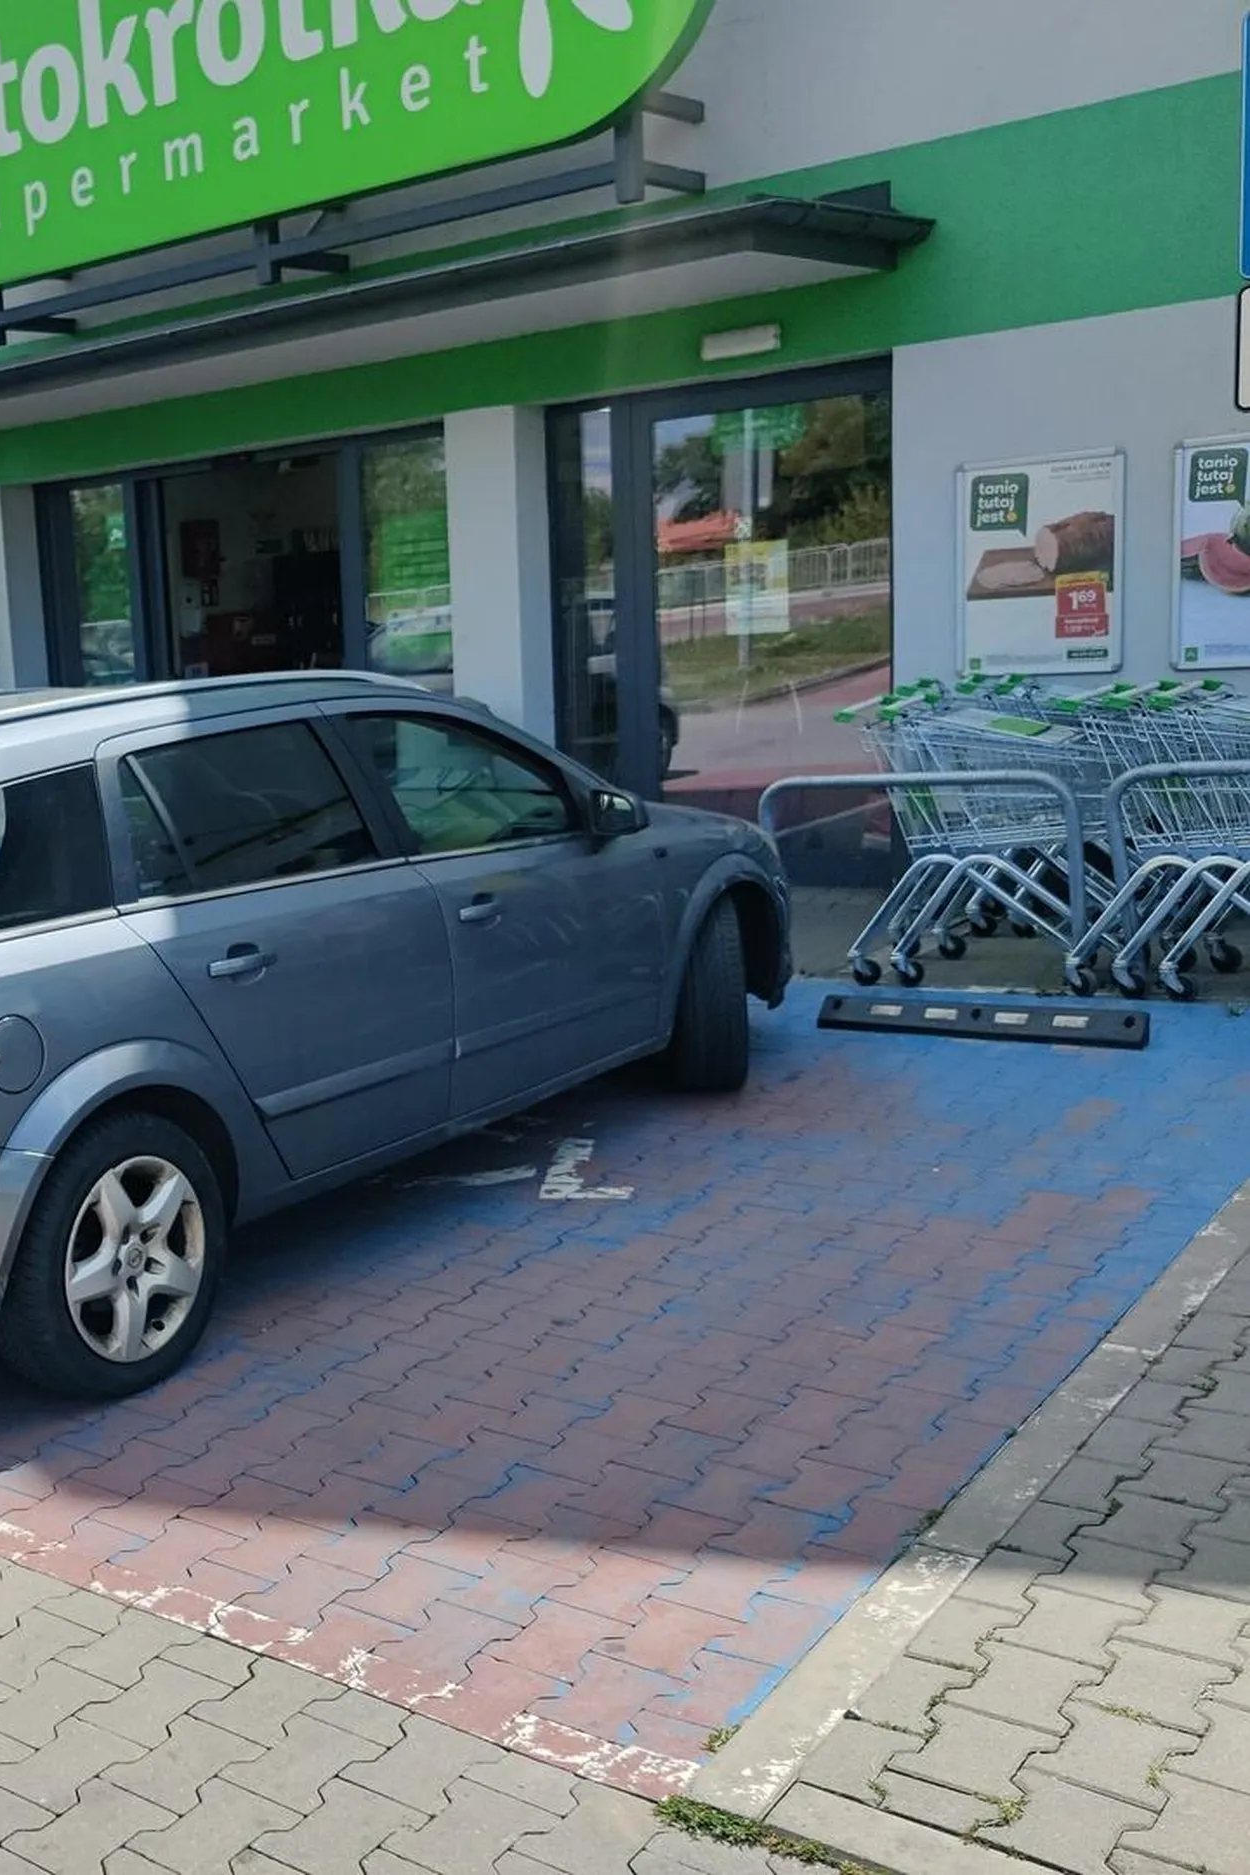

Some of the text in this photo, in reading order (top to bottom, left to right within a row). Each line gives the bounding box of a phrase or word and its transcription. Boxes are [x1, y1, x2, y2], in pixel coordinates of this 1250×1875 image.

[1198, 453, 1238, 469] tanio
[1197, 468, 1234, 483] tutaj
[979, 480, 1019, 495] tanio
[1195, 482, 1224, 499] jest
[978, 494, 1015, 511] tutaj
[976, 510, 1006, 527] jest
